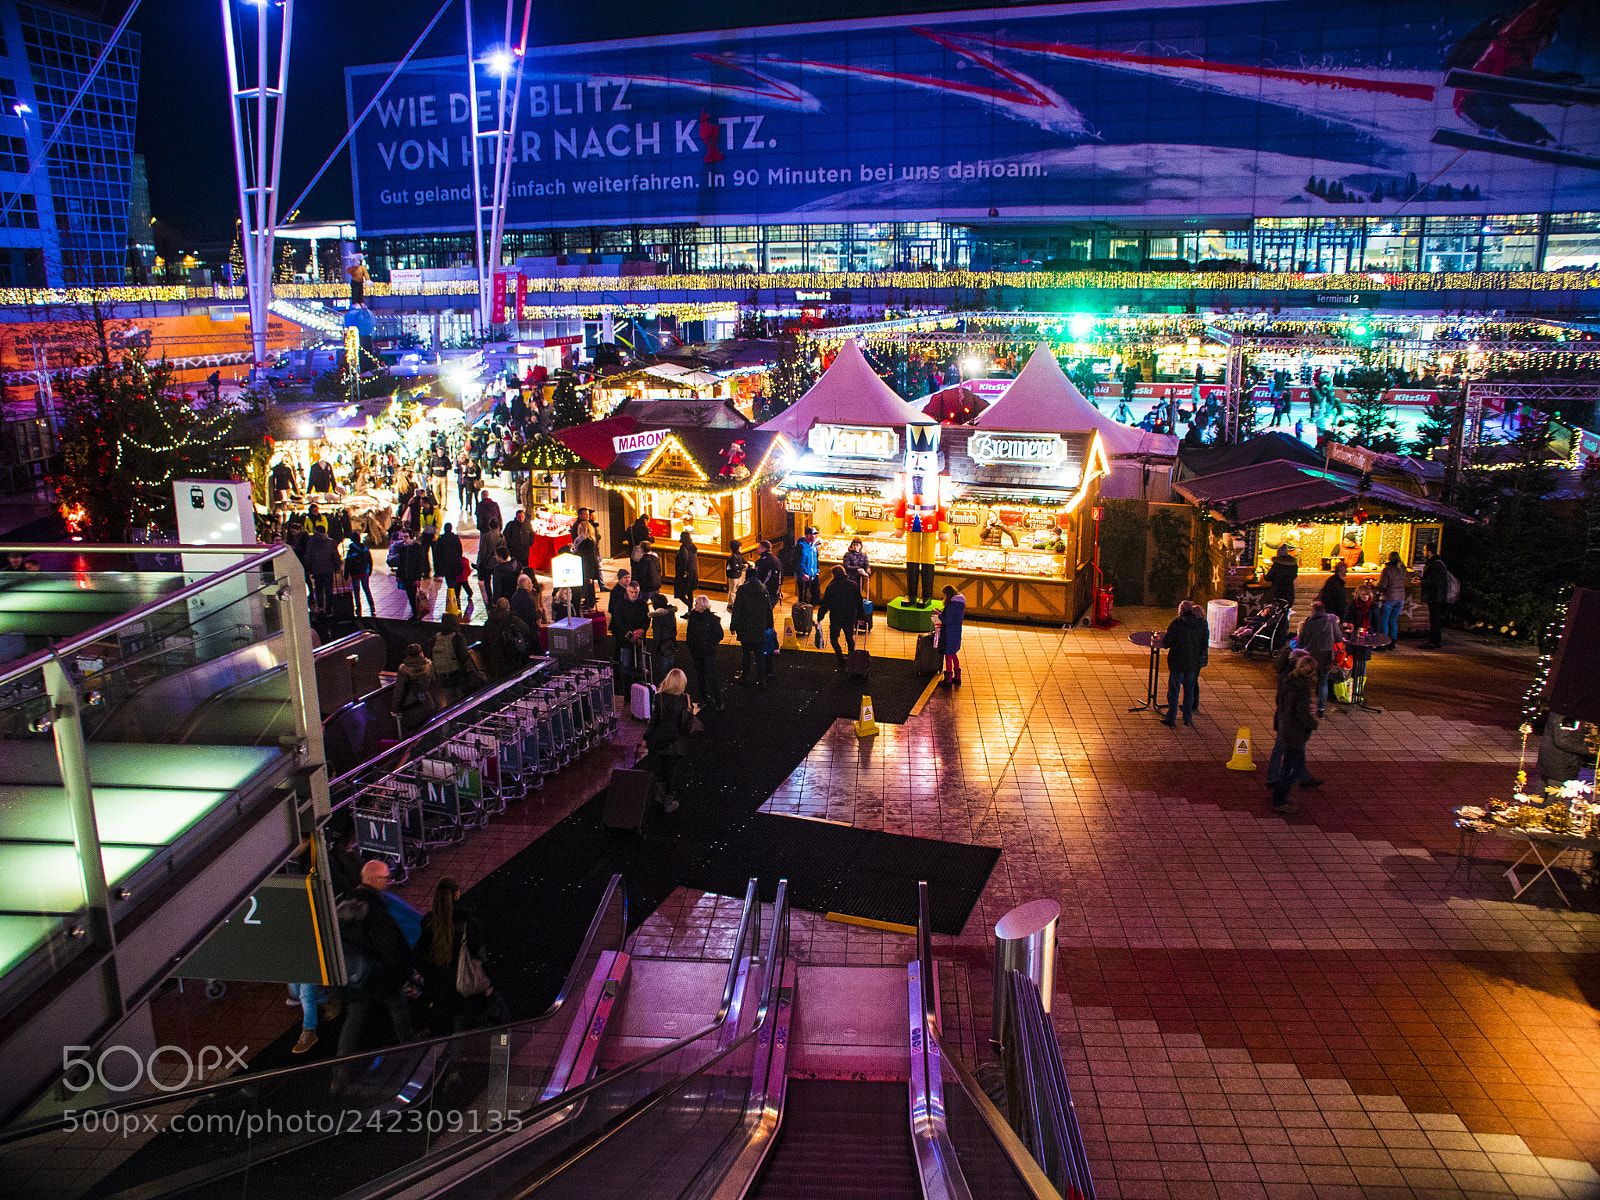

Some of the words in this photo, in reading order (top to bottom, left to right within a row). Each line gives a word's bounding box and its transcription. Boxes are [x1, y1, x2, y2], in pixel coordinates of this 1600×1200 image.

[376, 96, 437, 129] WIE
[450, 89, 518, 124] DER
[530, 77, 633, 118] BLITZ
[377, 138, 449, 171] VON
[461, 130, 541, 166] HIER
[554, 121, 661, 160] NACH
[381, 188, 409, 205] Gut
[415, 183, 494, 205] gelandt.
[572, 172, 699, 194] weiterfahren.
[708, 171, 726, 187] In
[733, 169, 760, 187] 90
[768, 166, 852, 186] Minuten
[860, 163, 894, 182] bei
[902, 164, 941, 181] uns
[949, 160, 1049, 179] dahoam.
[795, 291, 825, 301] Terminal
[825, 291, 832, 301] 2
[1317, 294, 1352, 303] Terminal
[1352, 294, 1360, 304] 2
[1394, 394, 1431, 402] KitzSki
[819, 426, 889, 455] Mandel
[975, 434, 1058, 460] Brennerei
[244, 895, 262, 925] 2
